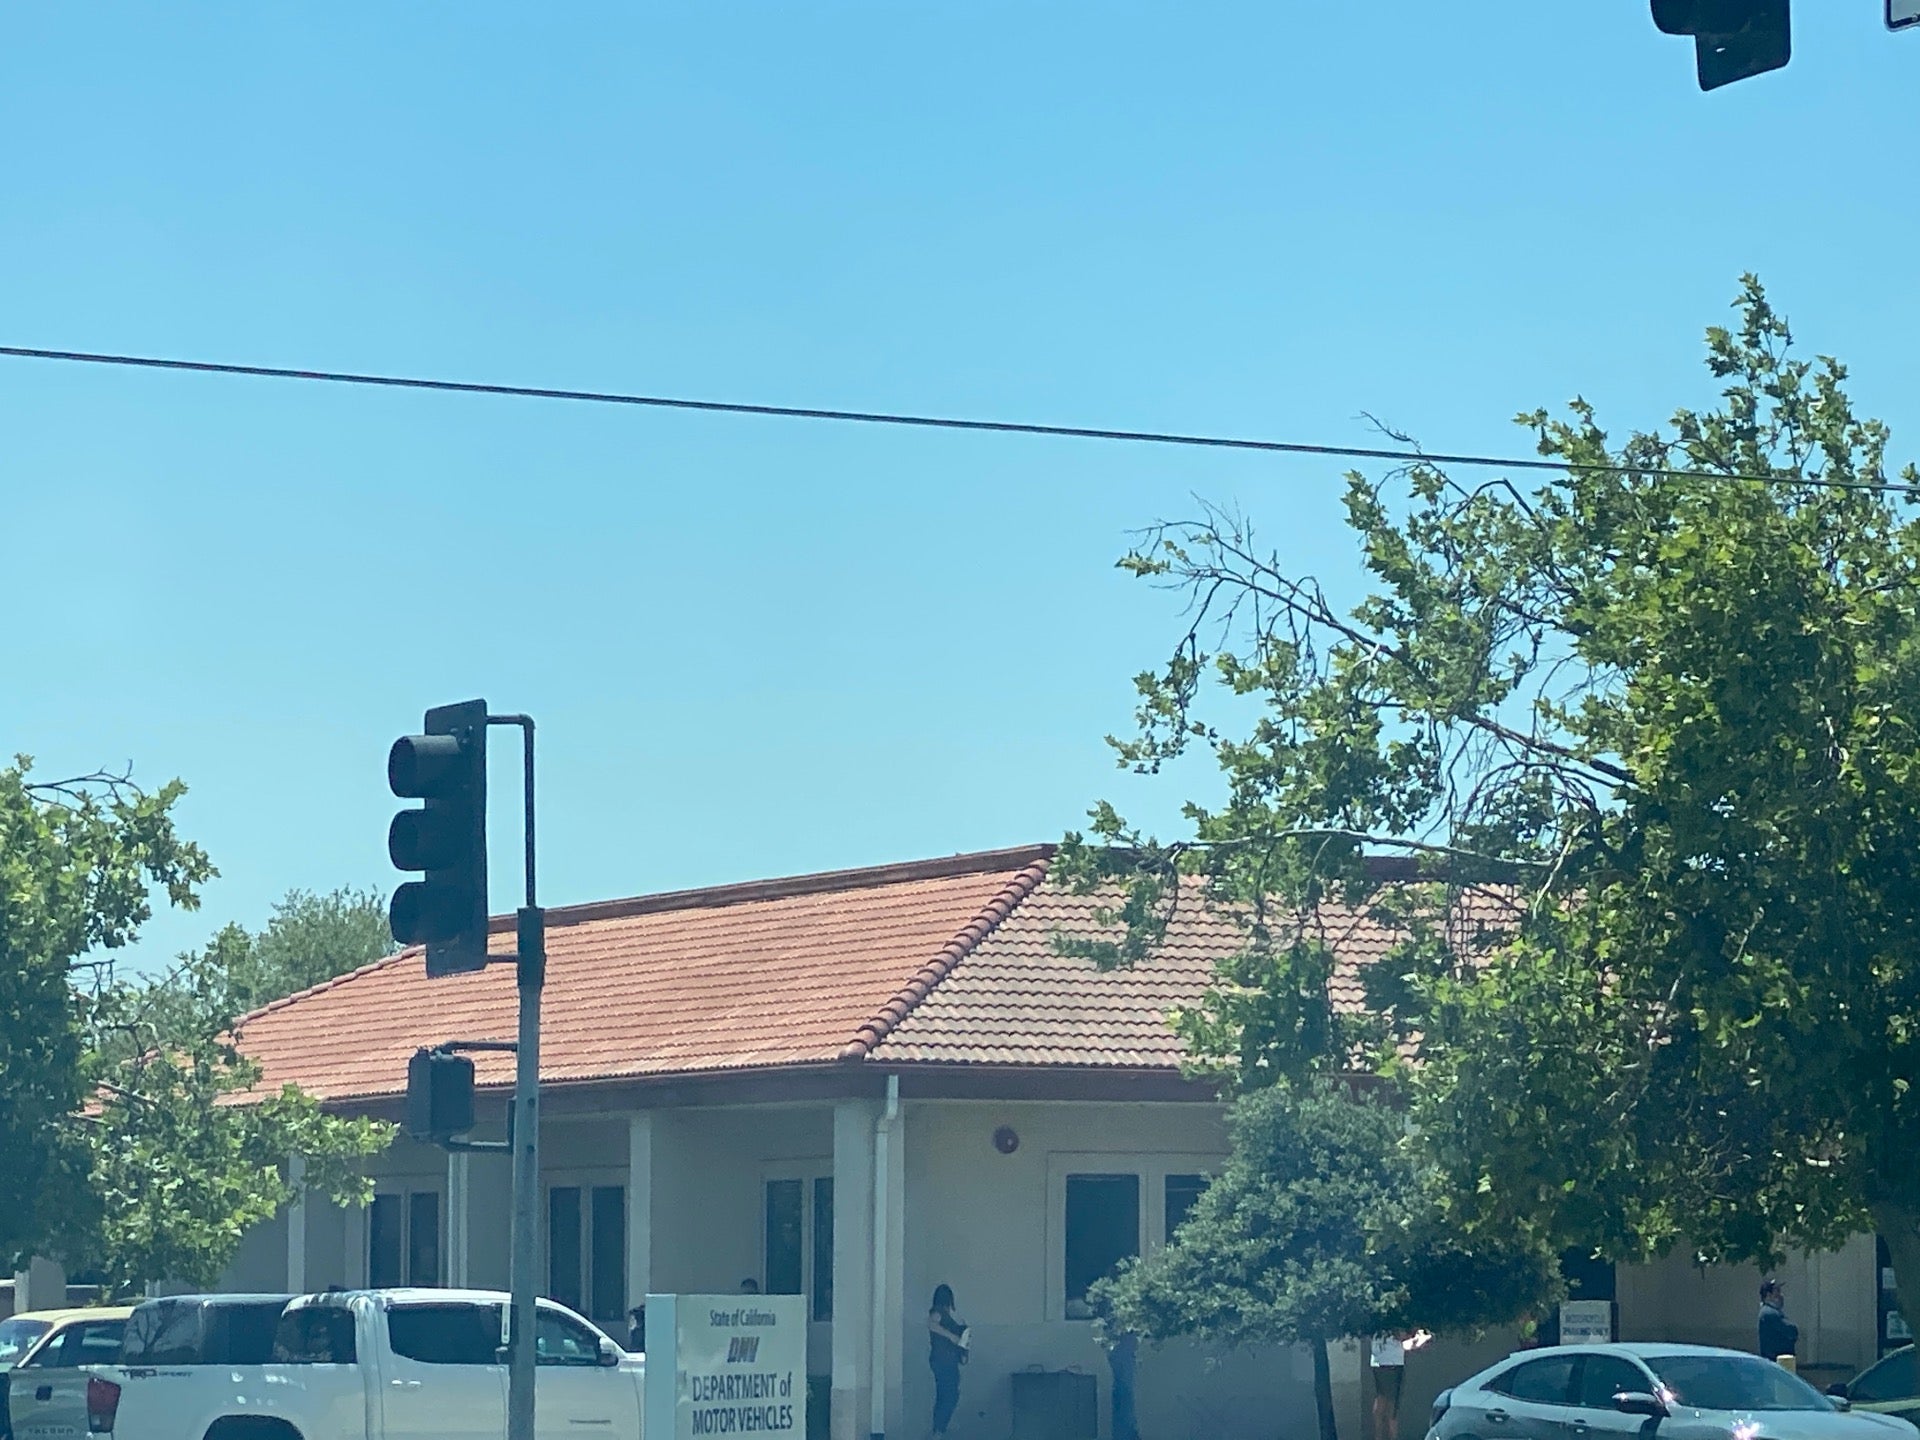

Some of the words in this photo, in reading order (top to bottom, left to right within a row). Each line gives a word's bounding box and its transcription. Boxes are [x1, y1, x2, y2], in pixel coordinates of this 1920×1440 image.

[710, 1310, 729, 1327] State
[731, 1309, 740, 1326] of
[740, 1309, 776, 1326] California
[727, 1336, 760, 1363] DMV
[692, 1373, 777, 1402] DEPARTMENT
[780, 1371, 792, 1398] of
[692, 1407, 736, 1435] MOTOR
[738, 1405, 793, 1432] VEHICLES
